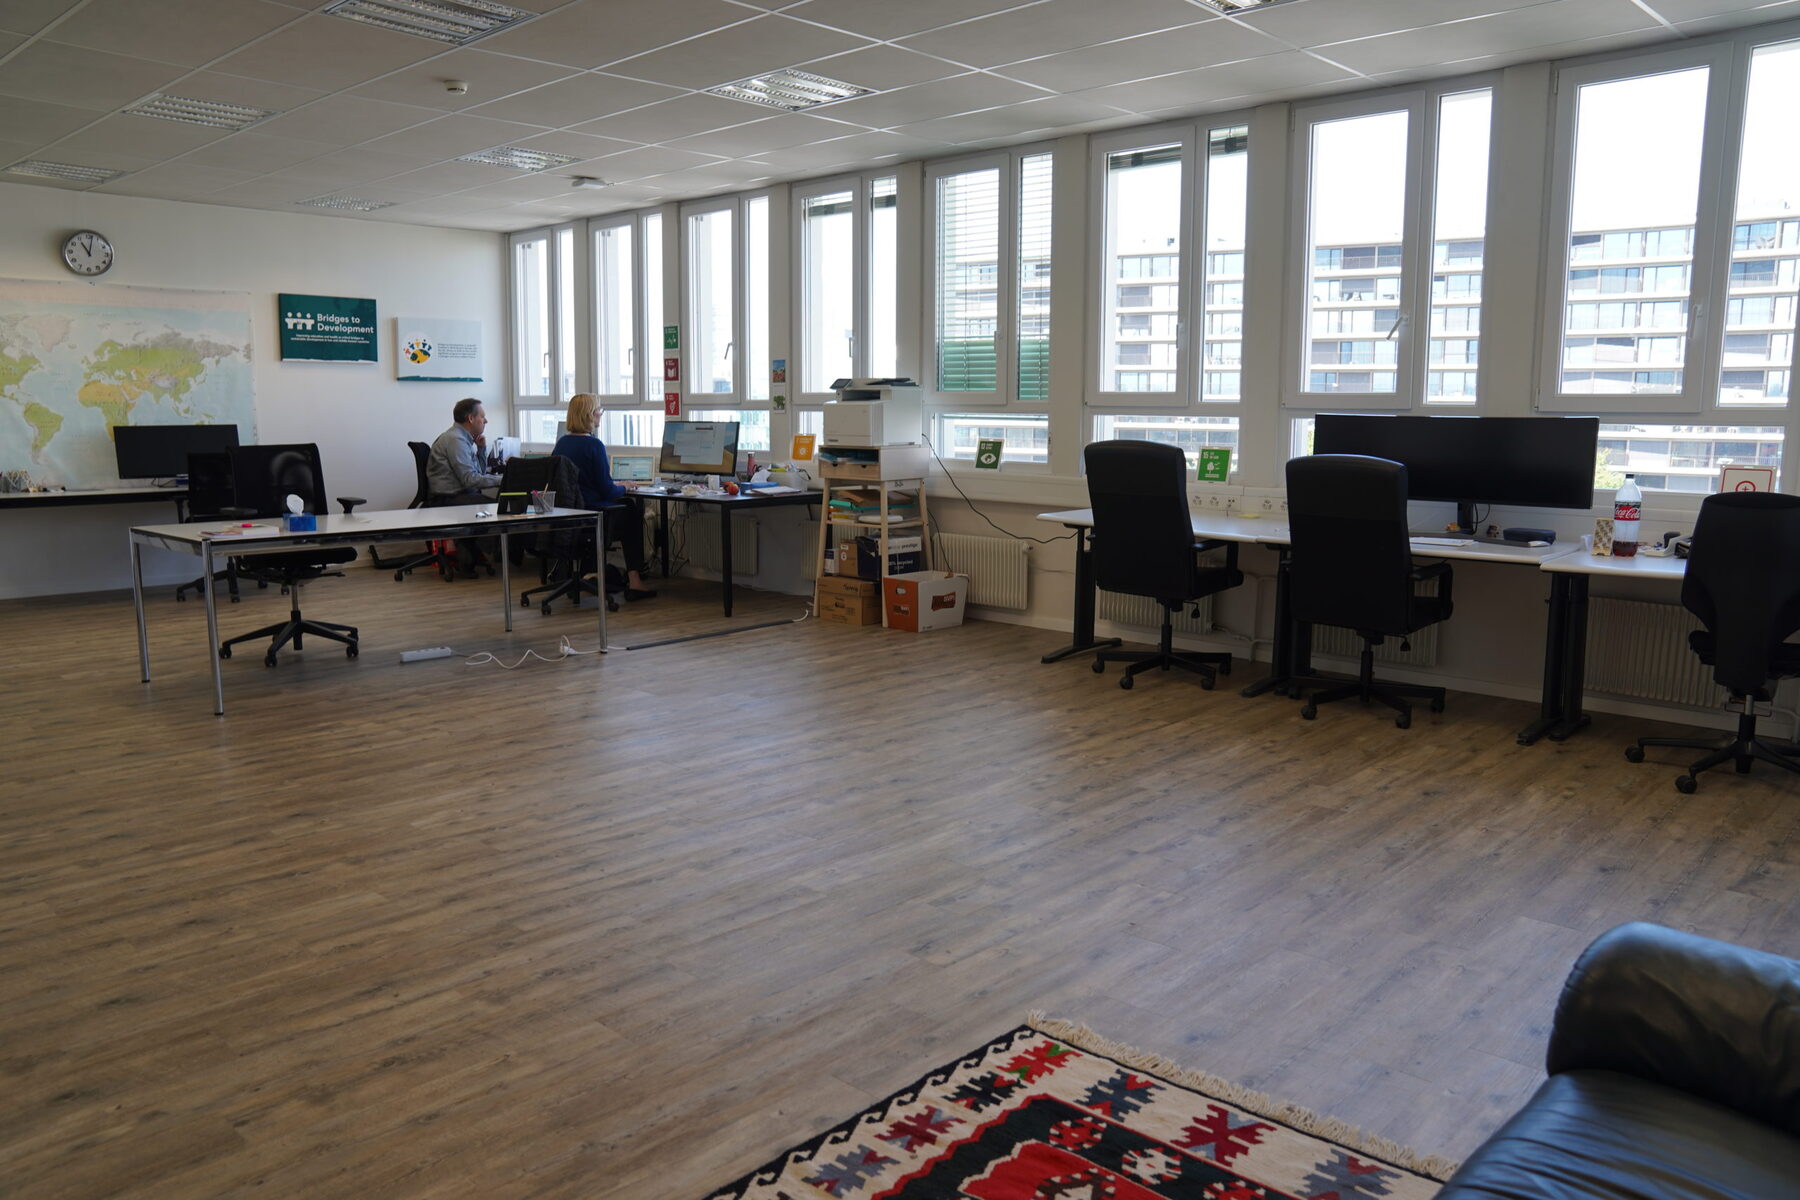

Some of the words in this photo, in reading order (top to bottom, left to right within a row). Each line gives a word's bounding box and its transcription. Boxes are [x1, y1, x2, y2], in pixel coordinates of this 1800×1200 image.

[317, 313, 349, 324] Bridges
[351, 316, 360, 324] to
[317, 323, 374, 334] Development
[1616, 507, 1640, 519] oca-Cola
